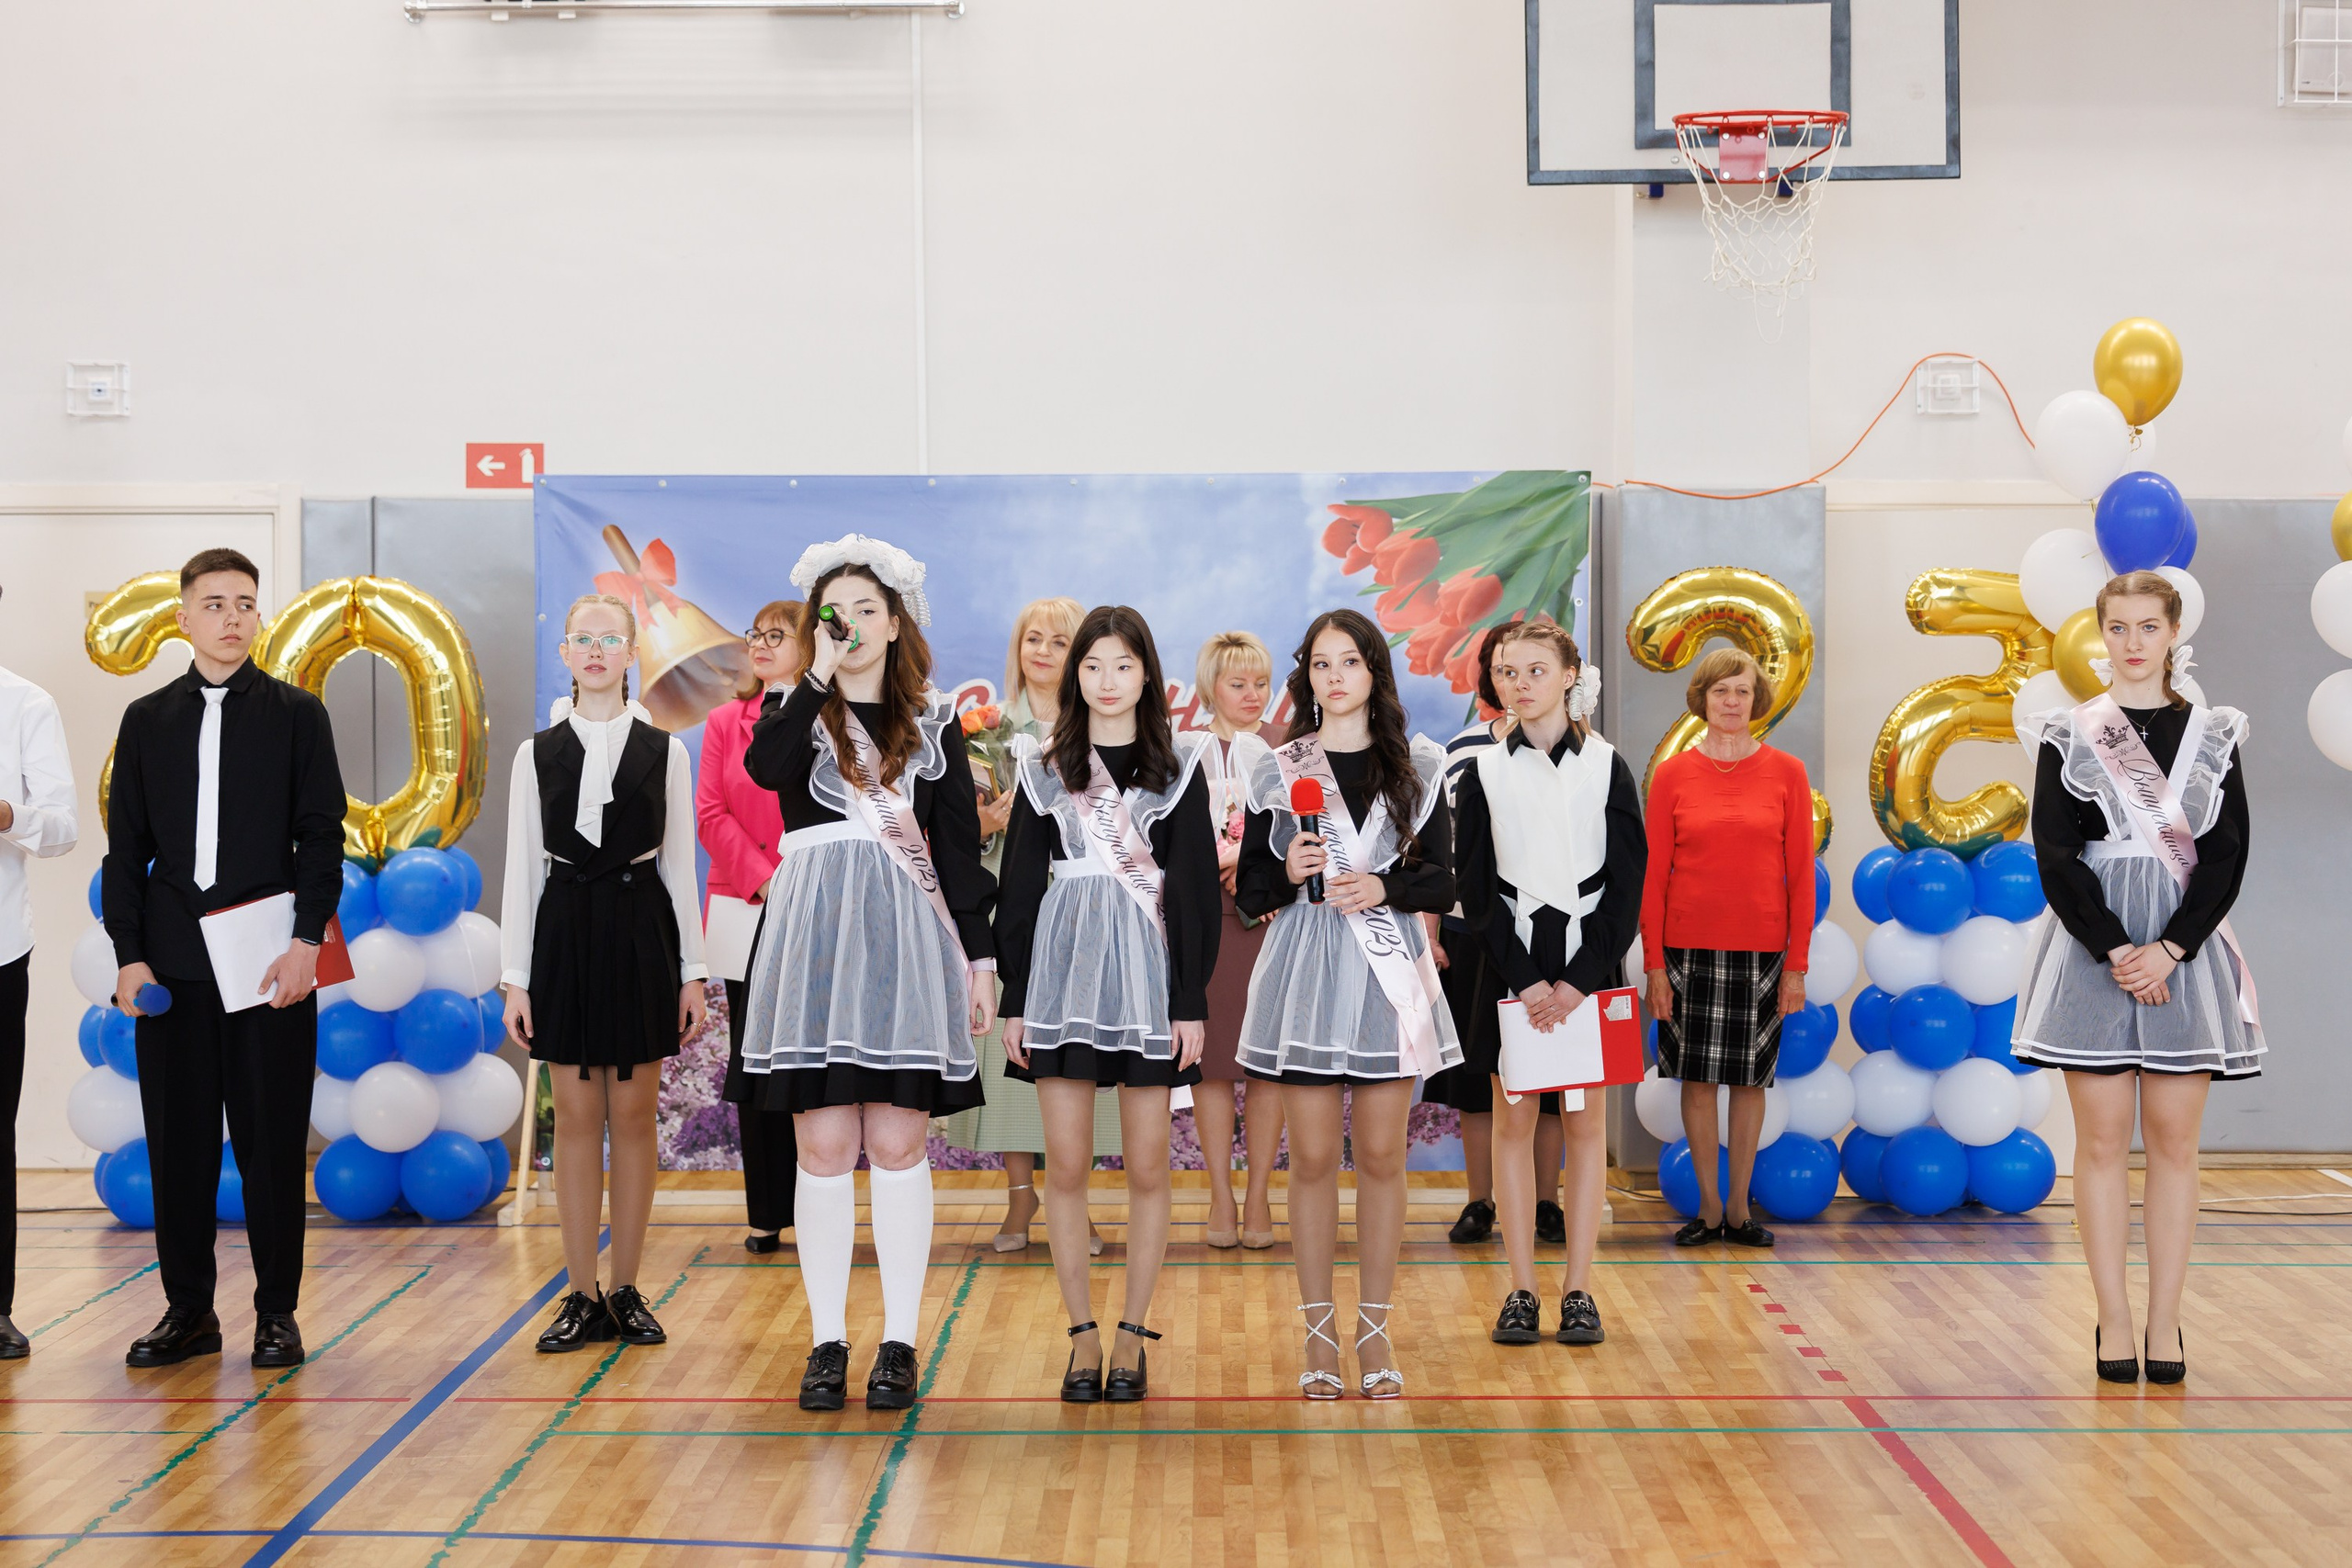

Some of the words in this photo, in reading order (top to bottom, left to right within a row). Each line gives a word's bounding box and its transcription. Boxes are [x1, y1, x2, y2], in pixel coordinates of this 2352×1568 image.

[1078, 784, 1159, 897] Выпускница
[2116, 758, 2190, 869] Выпускница
[1360, 905, 1410, 961] 2025
